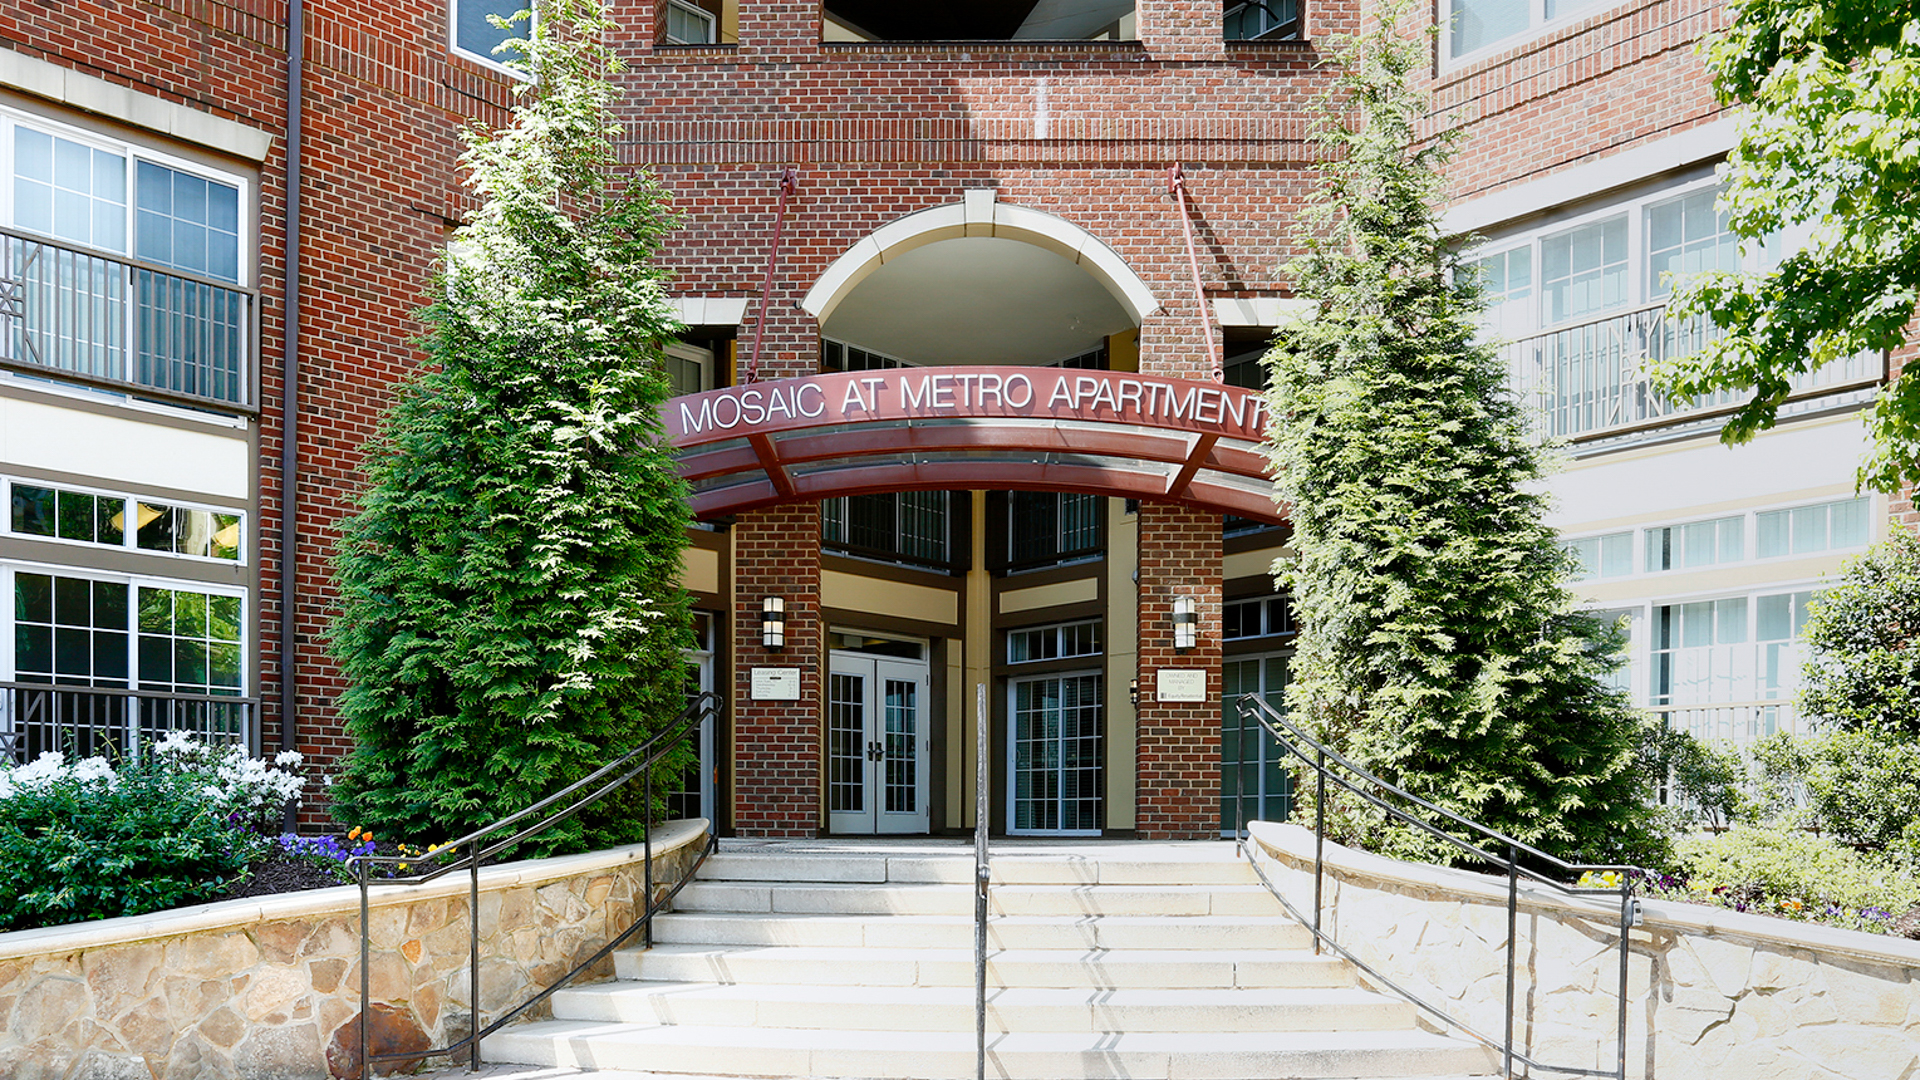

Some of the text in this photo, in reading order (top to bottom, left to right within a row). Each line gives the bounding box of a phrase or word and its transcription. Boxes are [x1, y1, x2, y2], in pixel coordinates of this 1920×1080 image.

[680, 383, 825, 435] MOSAIC
[840, 378, 885, 413] AT
[900, 373, 1033, 409] METRO
